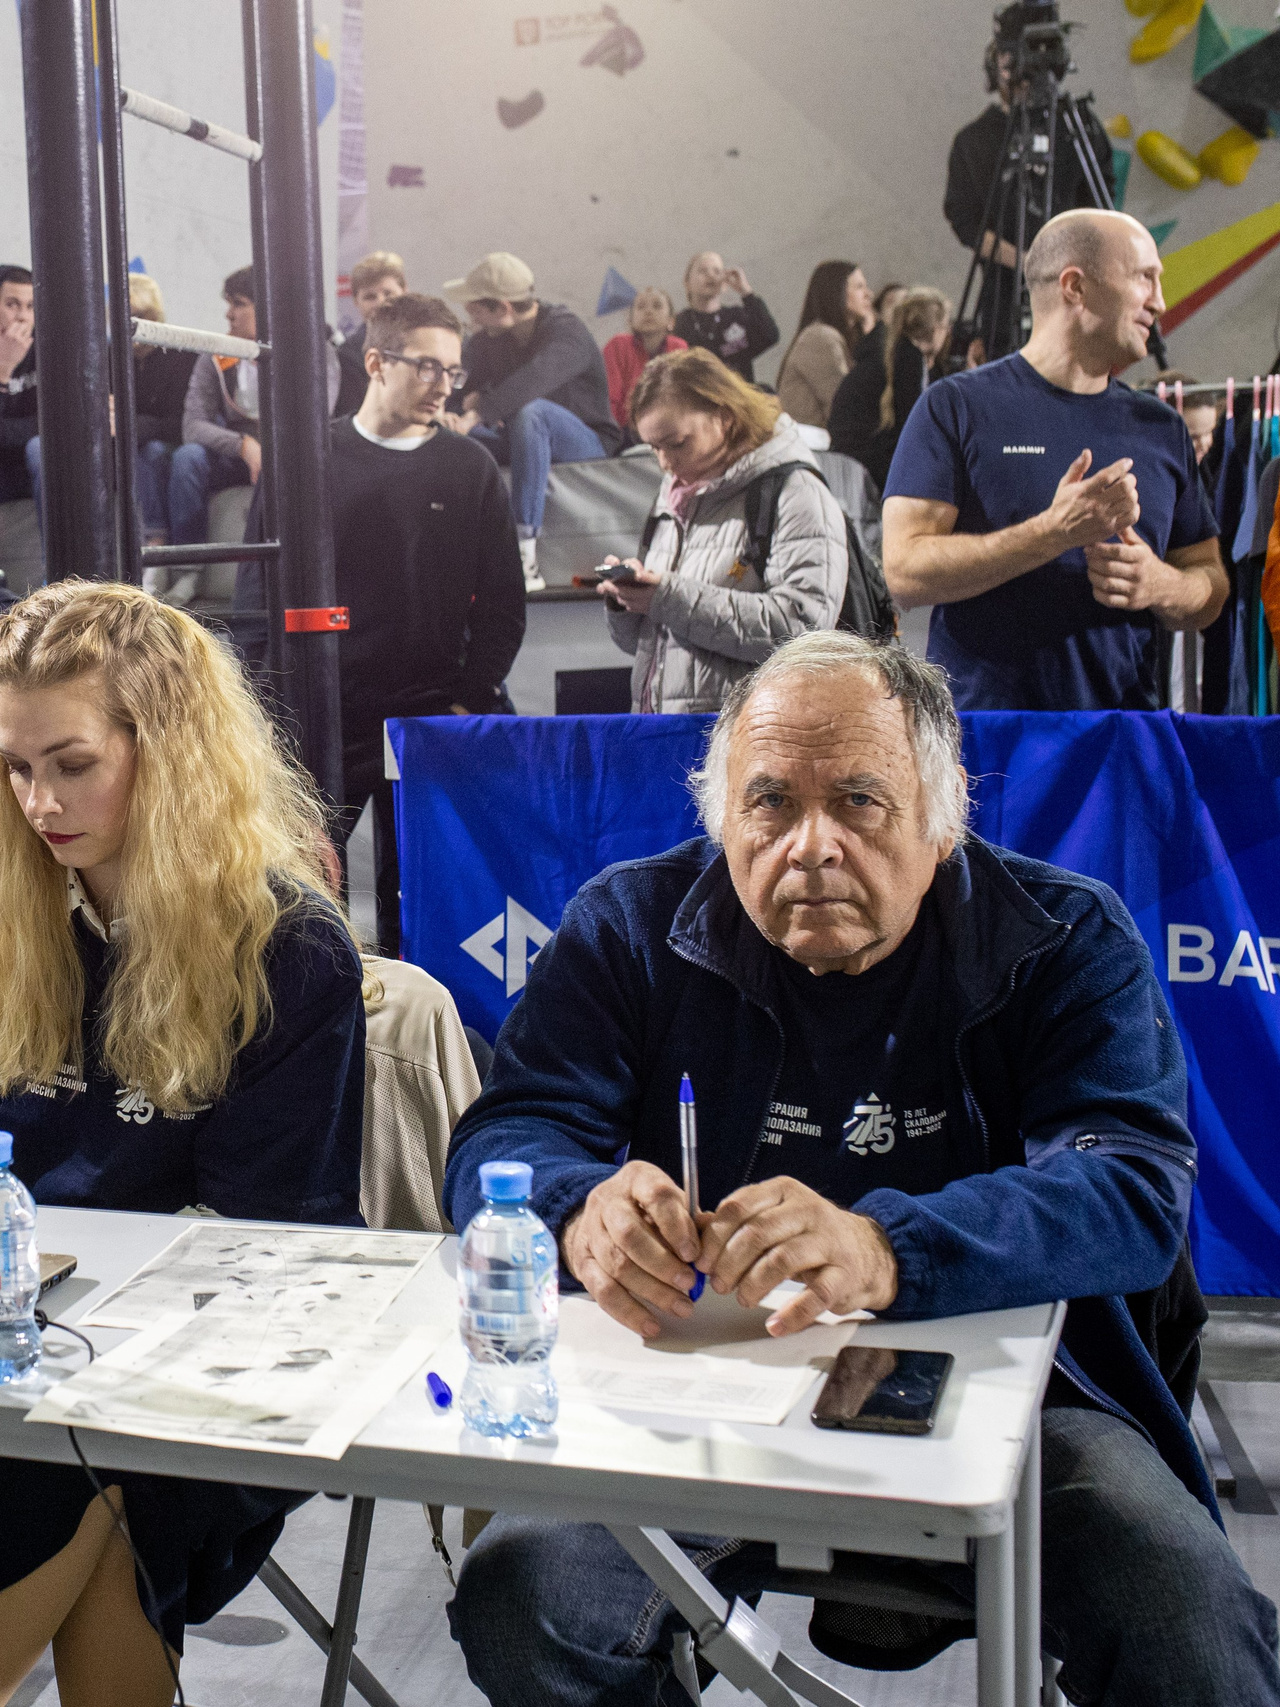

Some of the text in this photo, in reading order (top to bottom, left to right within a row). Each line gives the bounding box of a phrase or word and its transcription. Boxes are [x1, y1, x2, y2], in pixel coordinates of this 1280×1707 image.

[1003, 445, 1046, 454] MAMMUT
[770, 1101, 809, 1119] ЕРАЦИЯ
[903, 1109, 913, 1119] 75
